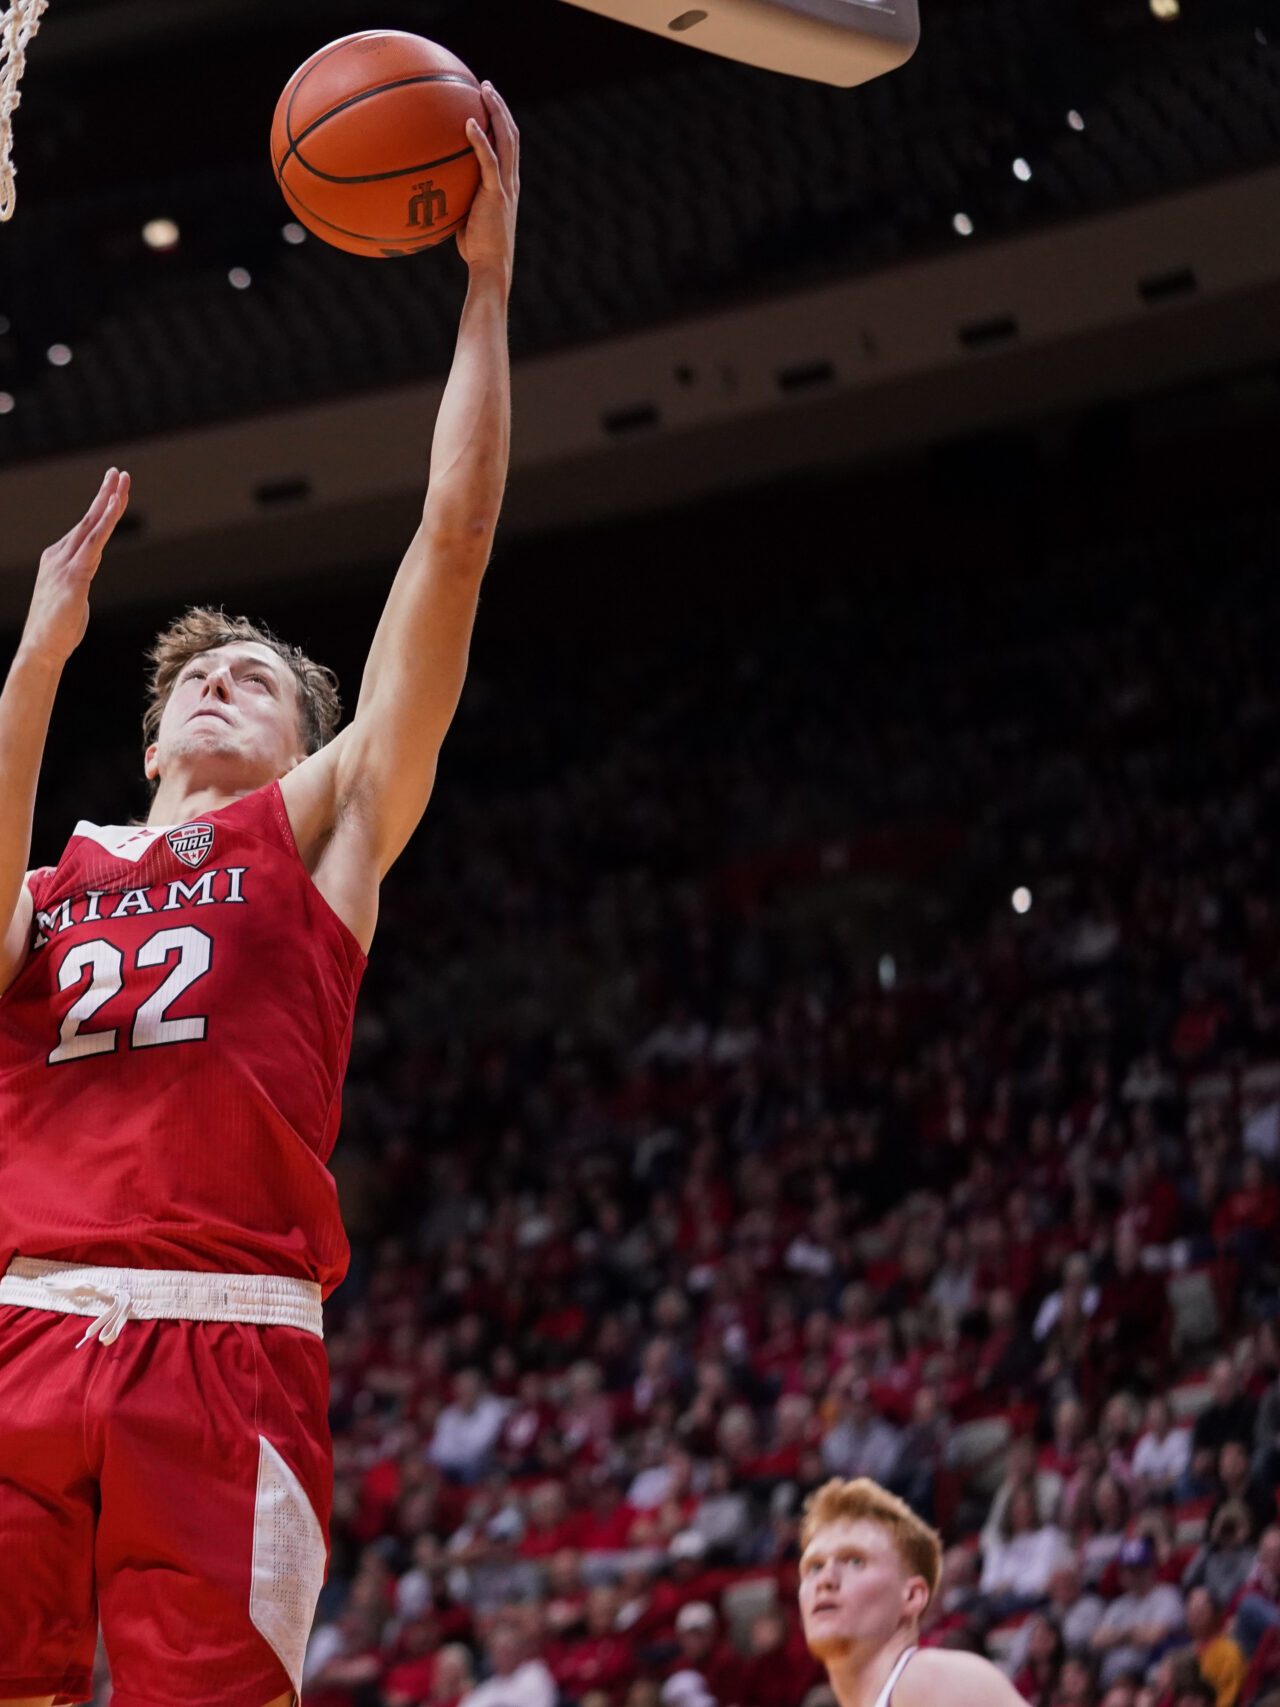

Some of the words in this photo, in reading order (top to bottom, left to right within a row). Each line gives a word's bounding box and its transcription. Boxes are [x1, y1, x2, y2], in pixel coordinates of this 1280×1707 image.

[173, 834, 212, 852] MAC
[34, 867, 249, 950] MIAMI
[46, 924, 215, 1067] 22
